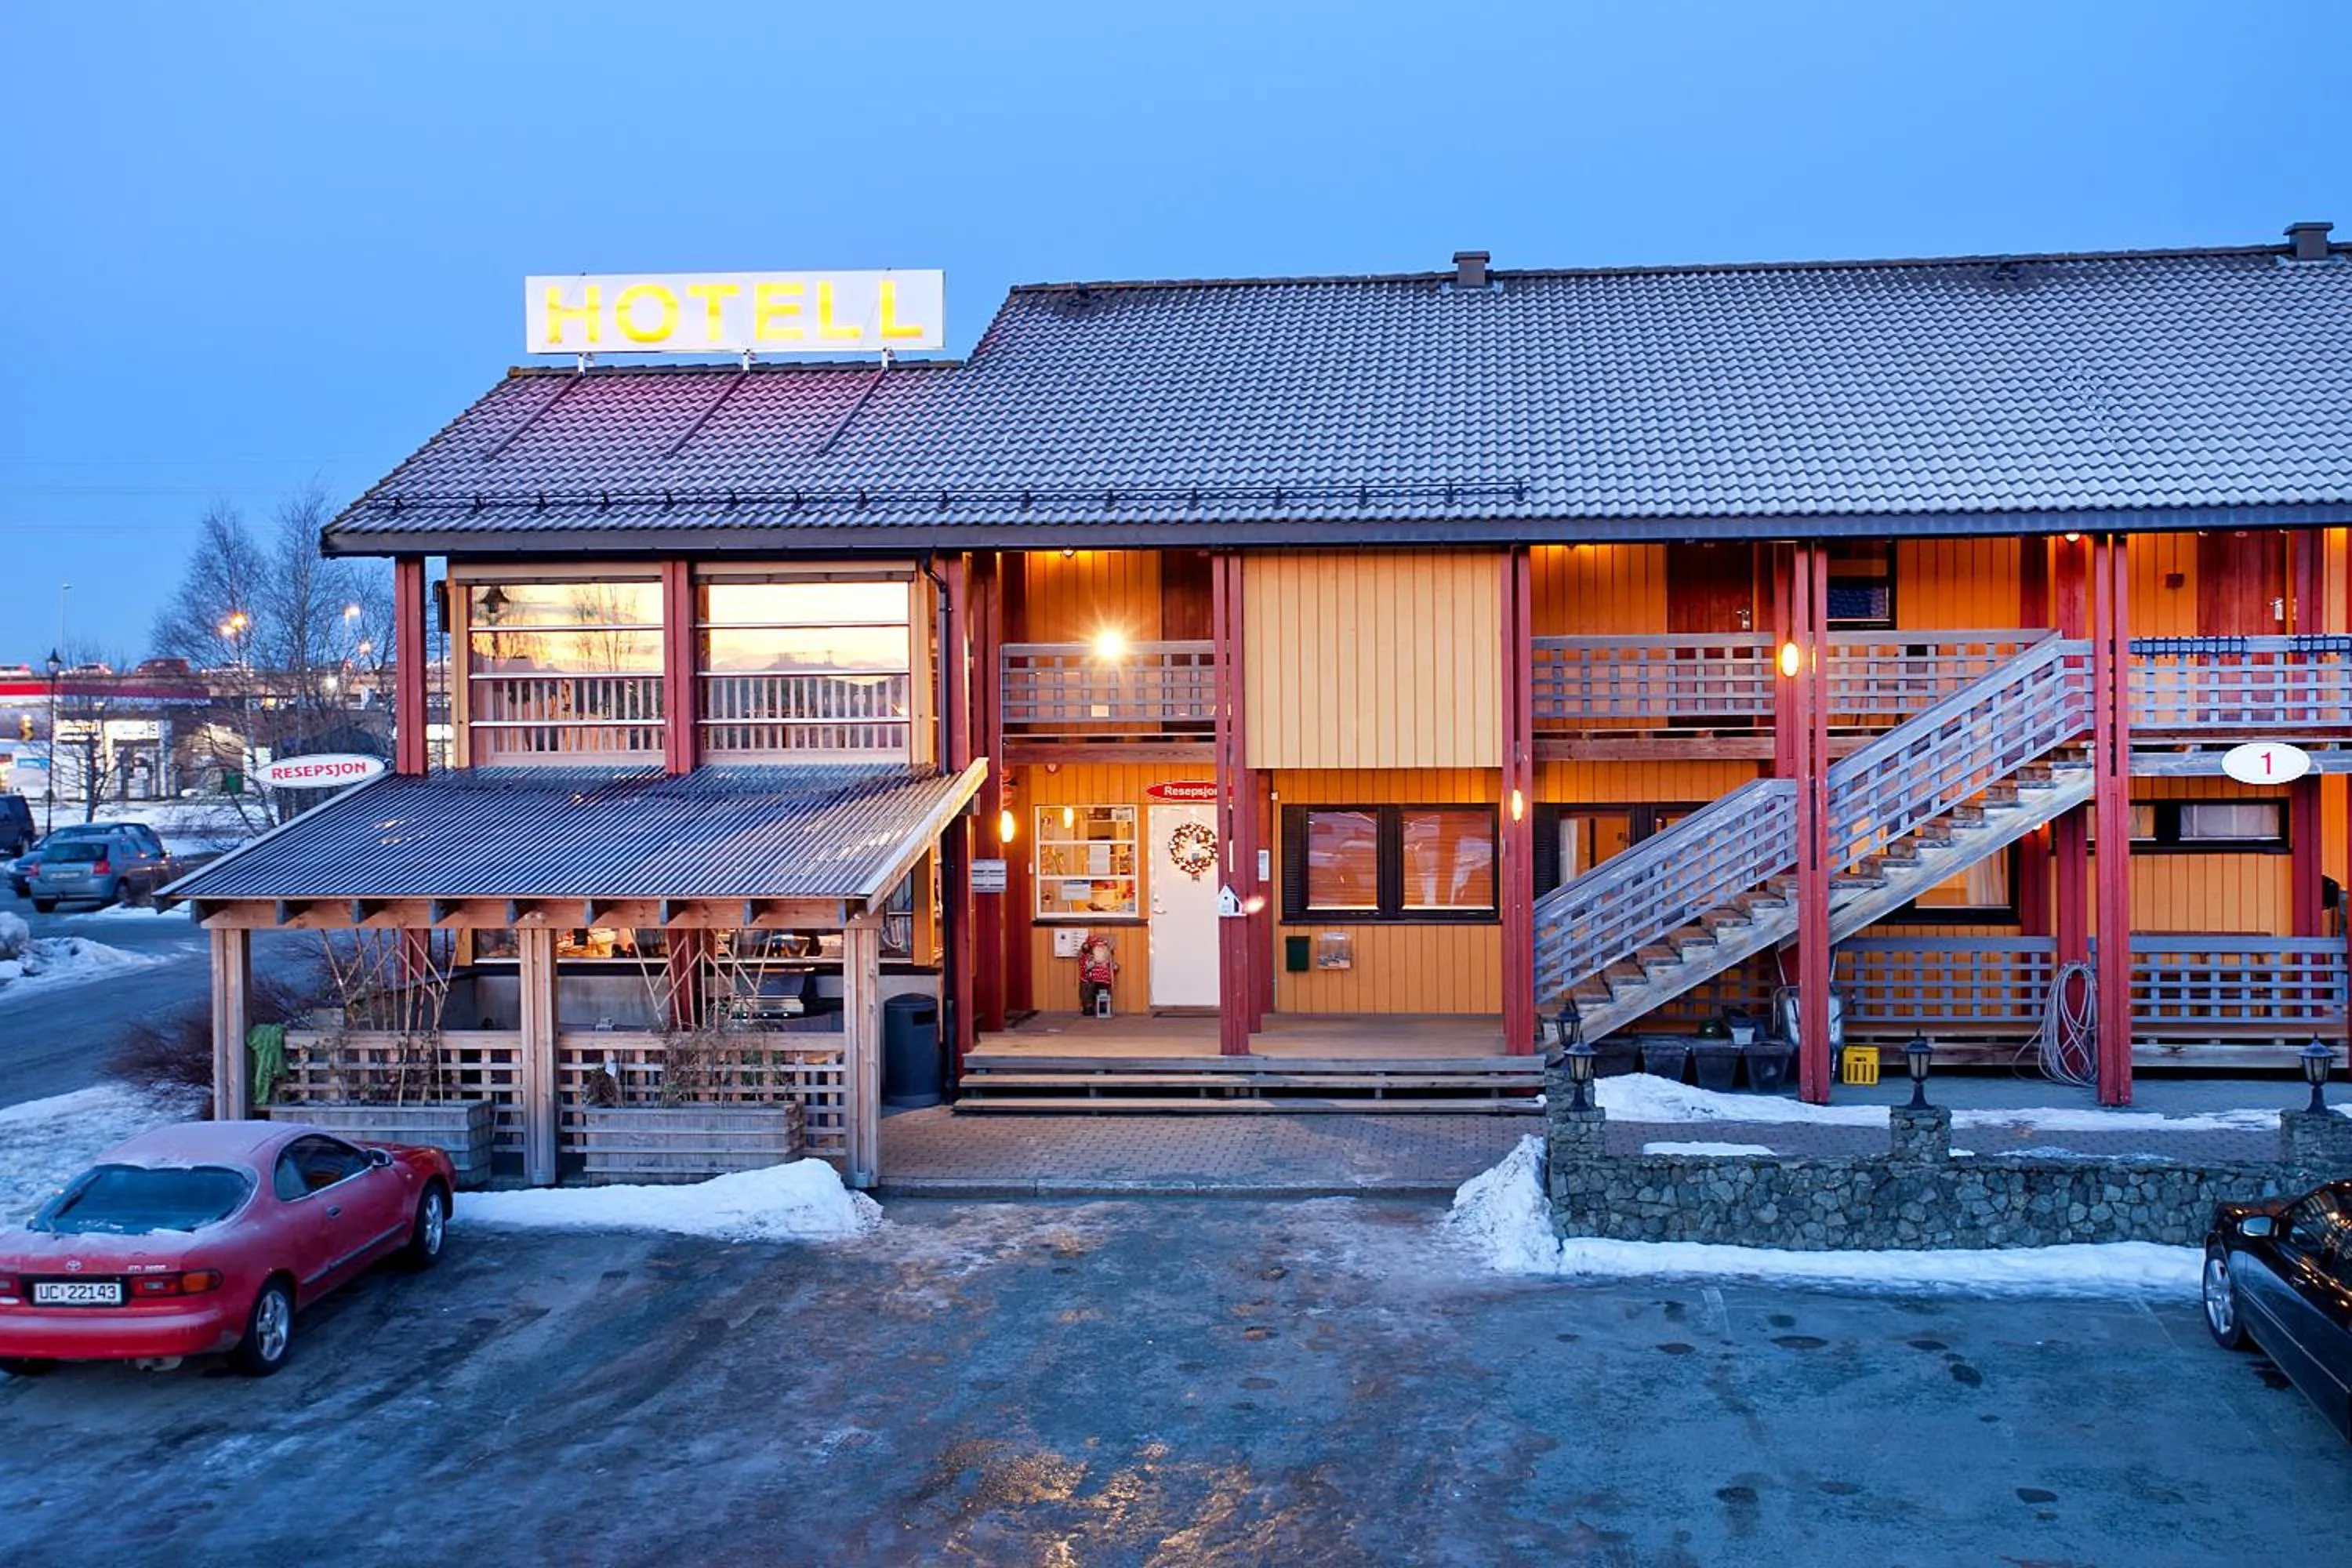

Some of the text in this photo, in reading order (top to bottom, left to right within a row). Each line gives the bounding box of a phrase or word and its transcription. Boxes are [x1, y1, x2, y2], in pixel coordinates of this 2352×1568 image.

[544, 281, 924, 344] HOTELL
[271, 762, 367, 780] RESEPSJON
[2260, 751, 2271, 775] 1
[67, 1285, 117, 1300] 22143
